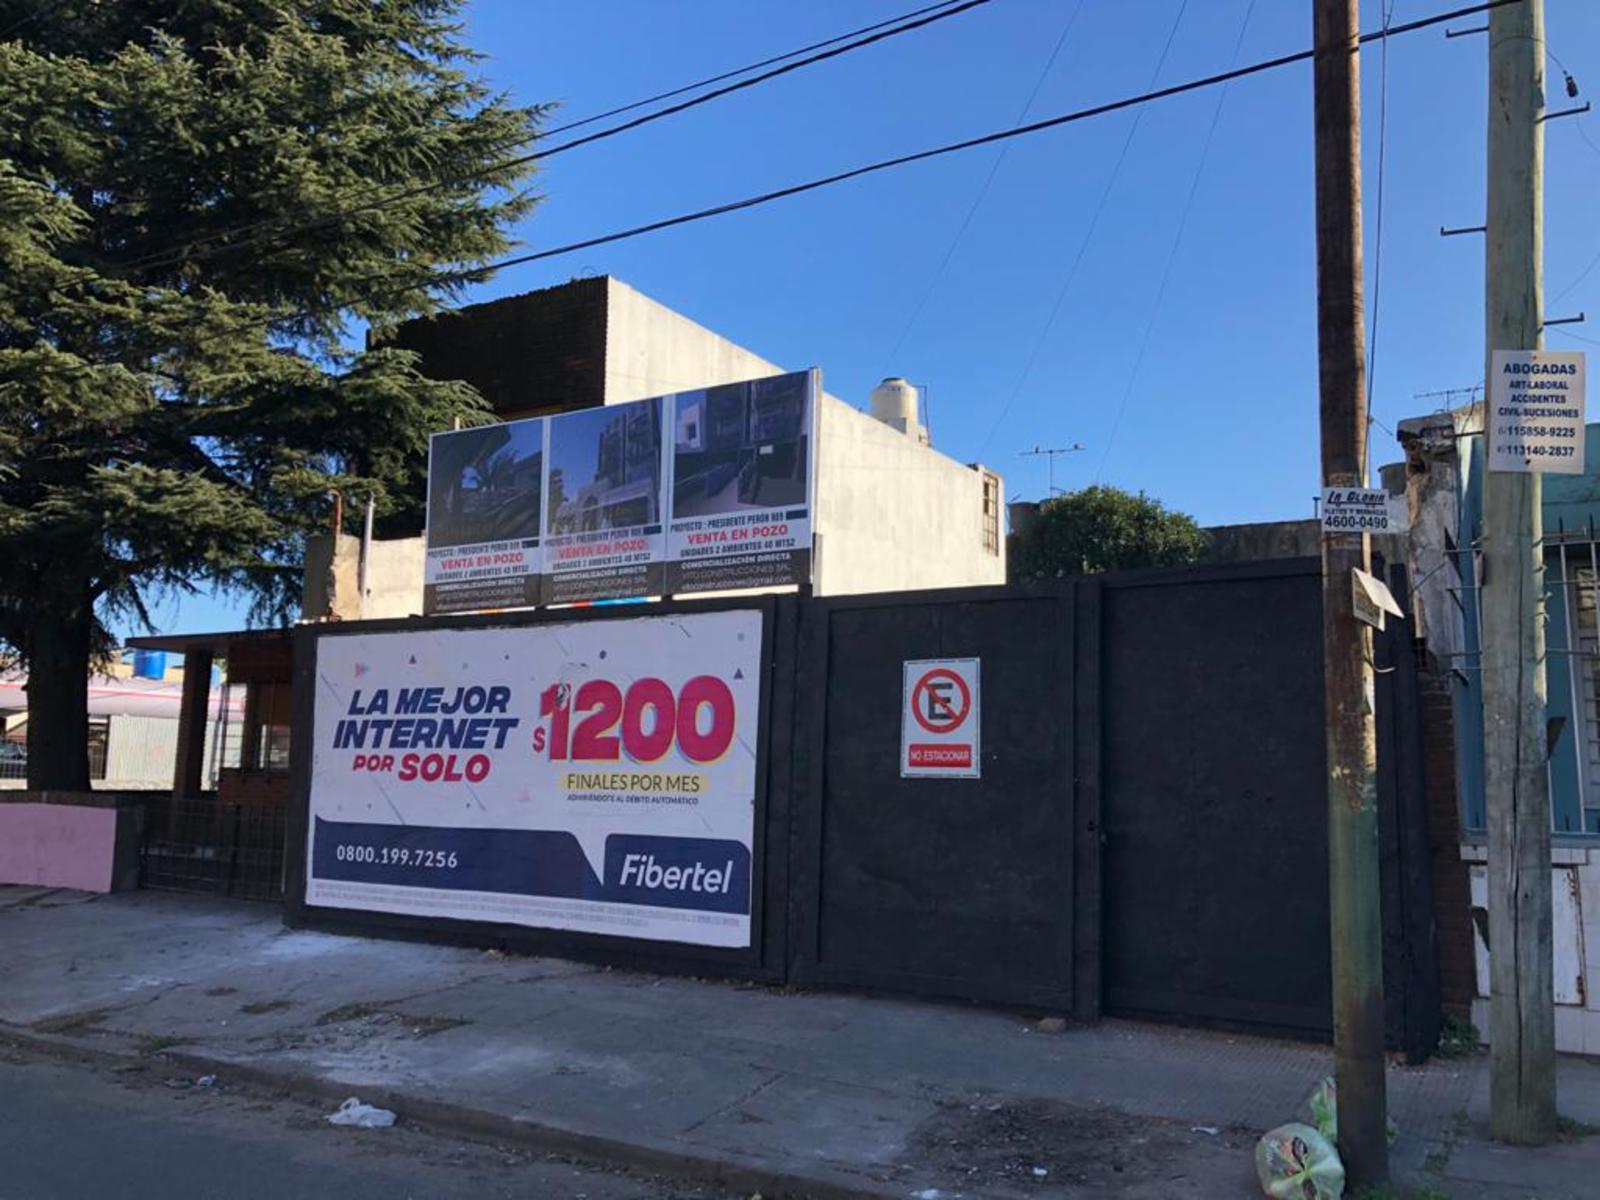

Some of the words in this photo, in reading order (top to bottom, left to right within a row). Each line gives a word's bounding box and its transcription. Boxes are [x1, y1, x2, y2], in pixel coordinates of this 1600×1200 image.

[1503, 363, 1577, 375] ABOGADAS
[1509, 381, 1569, 390] ART-LABORAL
[1511, 395, 1566, 404] ACCIDENTES
[1498, 407, 1580, 419] CIVIL-SUCESIONES
[1508, 426, 1576, 438] 115858-9225
[1507, 445, 1575, 457] 113140-2837
[1324, 515, 1388, 529] 4600-0490
[687, 531, 727, 545] VENTA
[732, 528, 748, 541] EN
[752, 524, 788, 538] POZO
[559, 544, 593, 559] VENTA
[597, 542, 610, 555] EN
[614, 538, 648, 553] POZO
[681, 547, 713, 557] UNIDADES
[716, 546, 720, 555] 2
[722, 541, 761, 554] AMBIENTES
[441, 557, 474, 571] VENTA
[477, 554, 492, 567] EN
[494, 552, 525, 564] POZO
[757, 552, 792, 563] DIRECTA
[348, 689, 388, 715] LA
[394, 686, 511, 715] MEJOR
[333, 718, 520, 750] INTERNET
[353, 755, 395, 772] POR
[398, 753, 491, 783] SOLO
[567, 774, 627, 790] FINALES
[630, 774, 662, 791] POR
[666, 775, 700, 792] MES
[337, 844, 458, 869] 0800.199.7256
[619, 853, 733, 894] Fibertel
